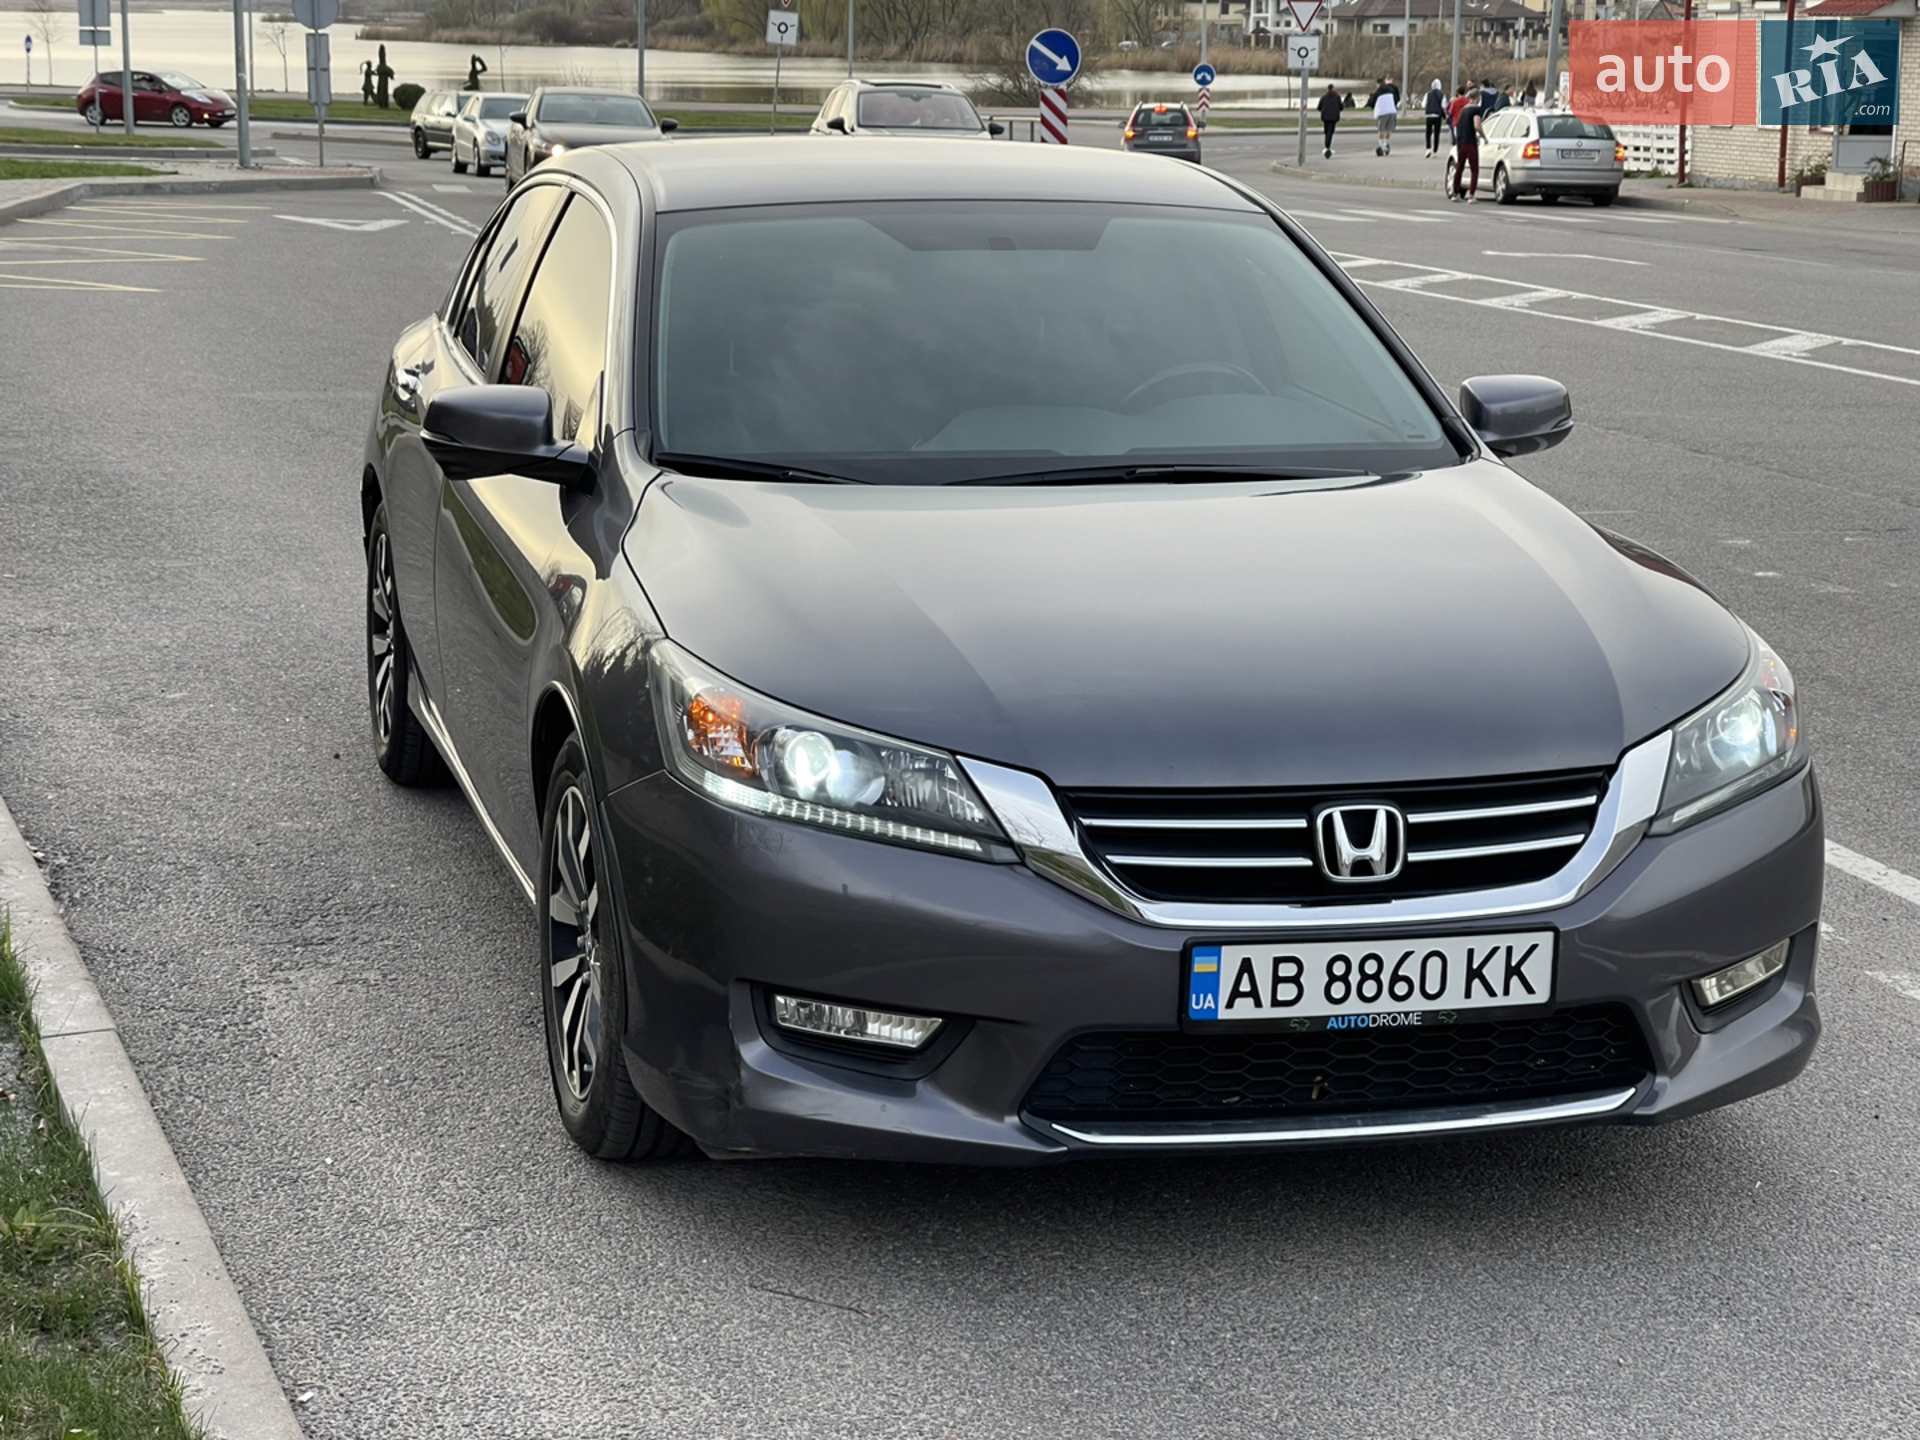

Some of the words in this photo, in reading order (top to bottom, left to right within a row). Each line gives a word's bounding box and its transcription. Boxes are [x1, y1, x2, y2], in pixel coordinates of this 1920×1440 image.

[1224, 954, 1305, 1010] AB
[1323, 949, 1449, 1006] 8860
[1464, 942, 1540, 1000] KK
[1191, 993, 1216, 1011] UA
[1326, 1011, 1423, 1030] AUTODROME
